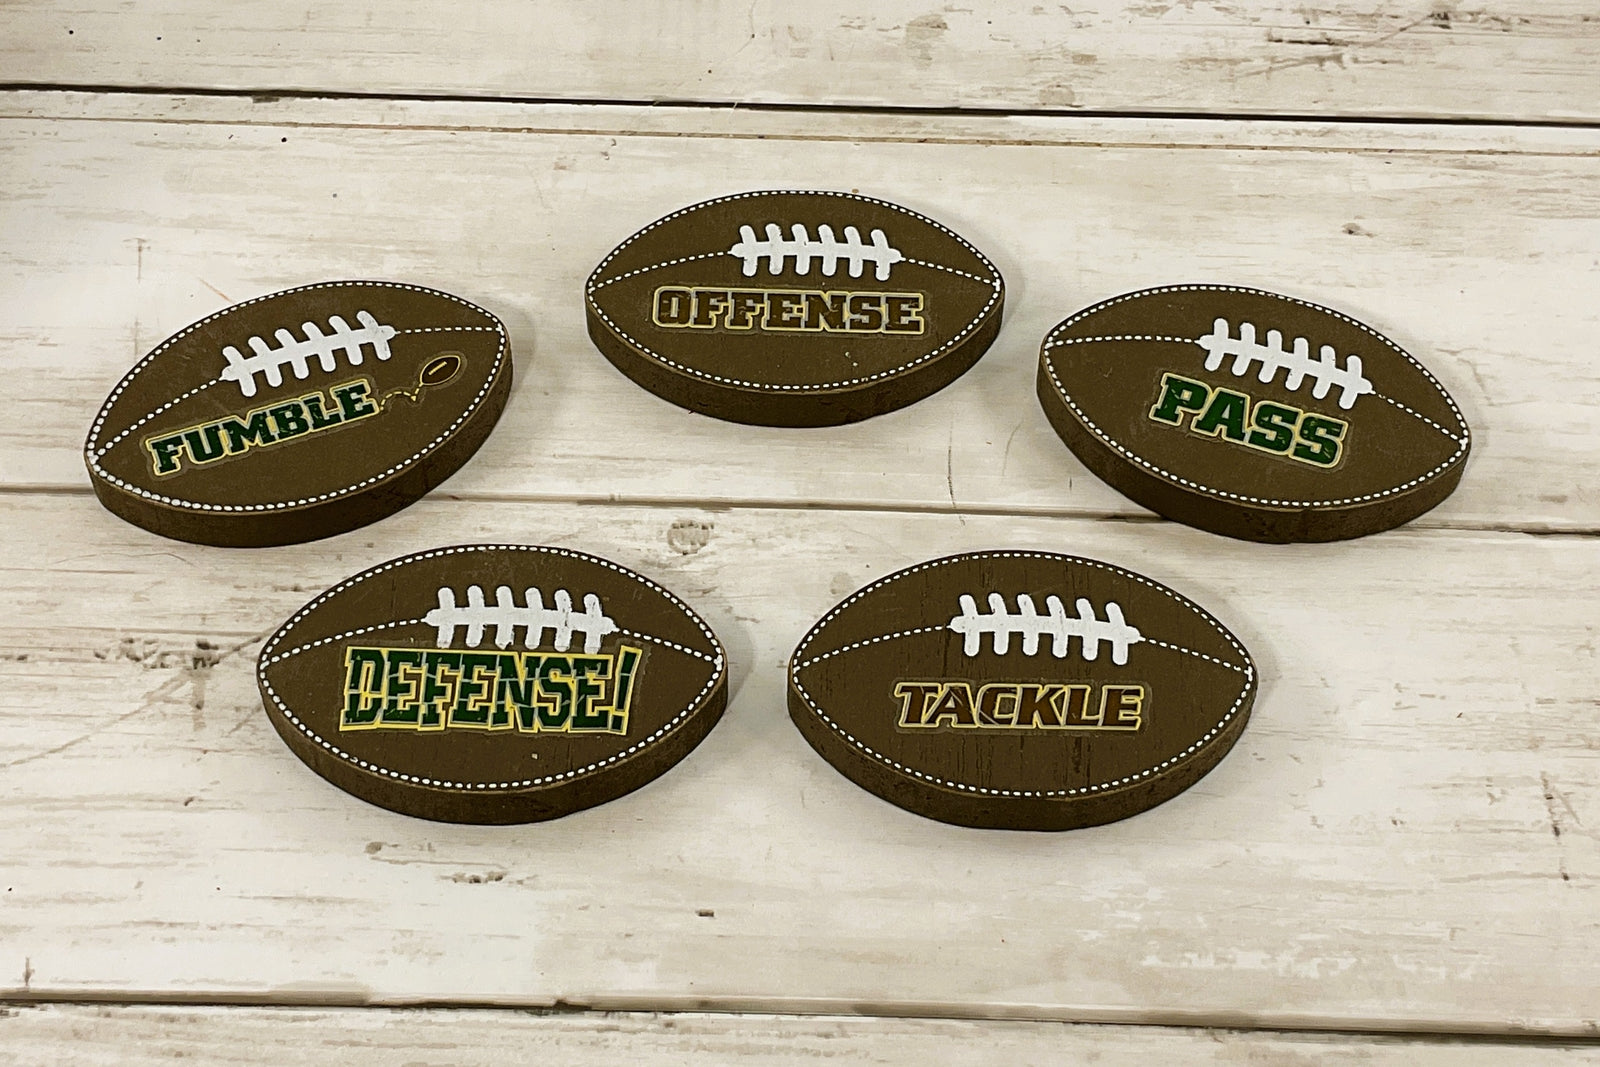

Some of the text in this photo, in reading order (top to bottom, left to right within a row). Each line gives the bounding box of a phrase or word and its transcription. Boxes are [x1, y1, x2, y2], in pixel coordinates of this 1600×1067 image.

[652, 286, 925, 335] OFFENSE
[145, 378, 380, 476] FUMBLE
[1149, 373, 1348, 468] PASS
[339, 646, 642, 735] DEFENSE!
[895, 683, 1145, 731] TACKLE
